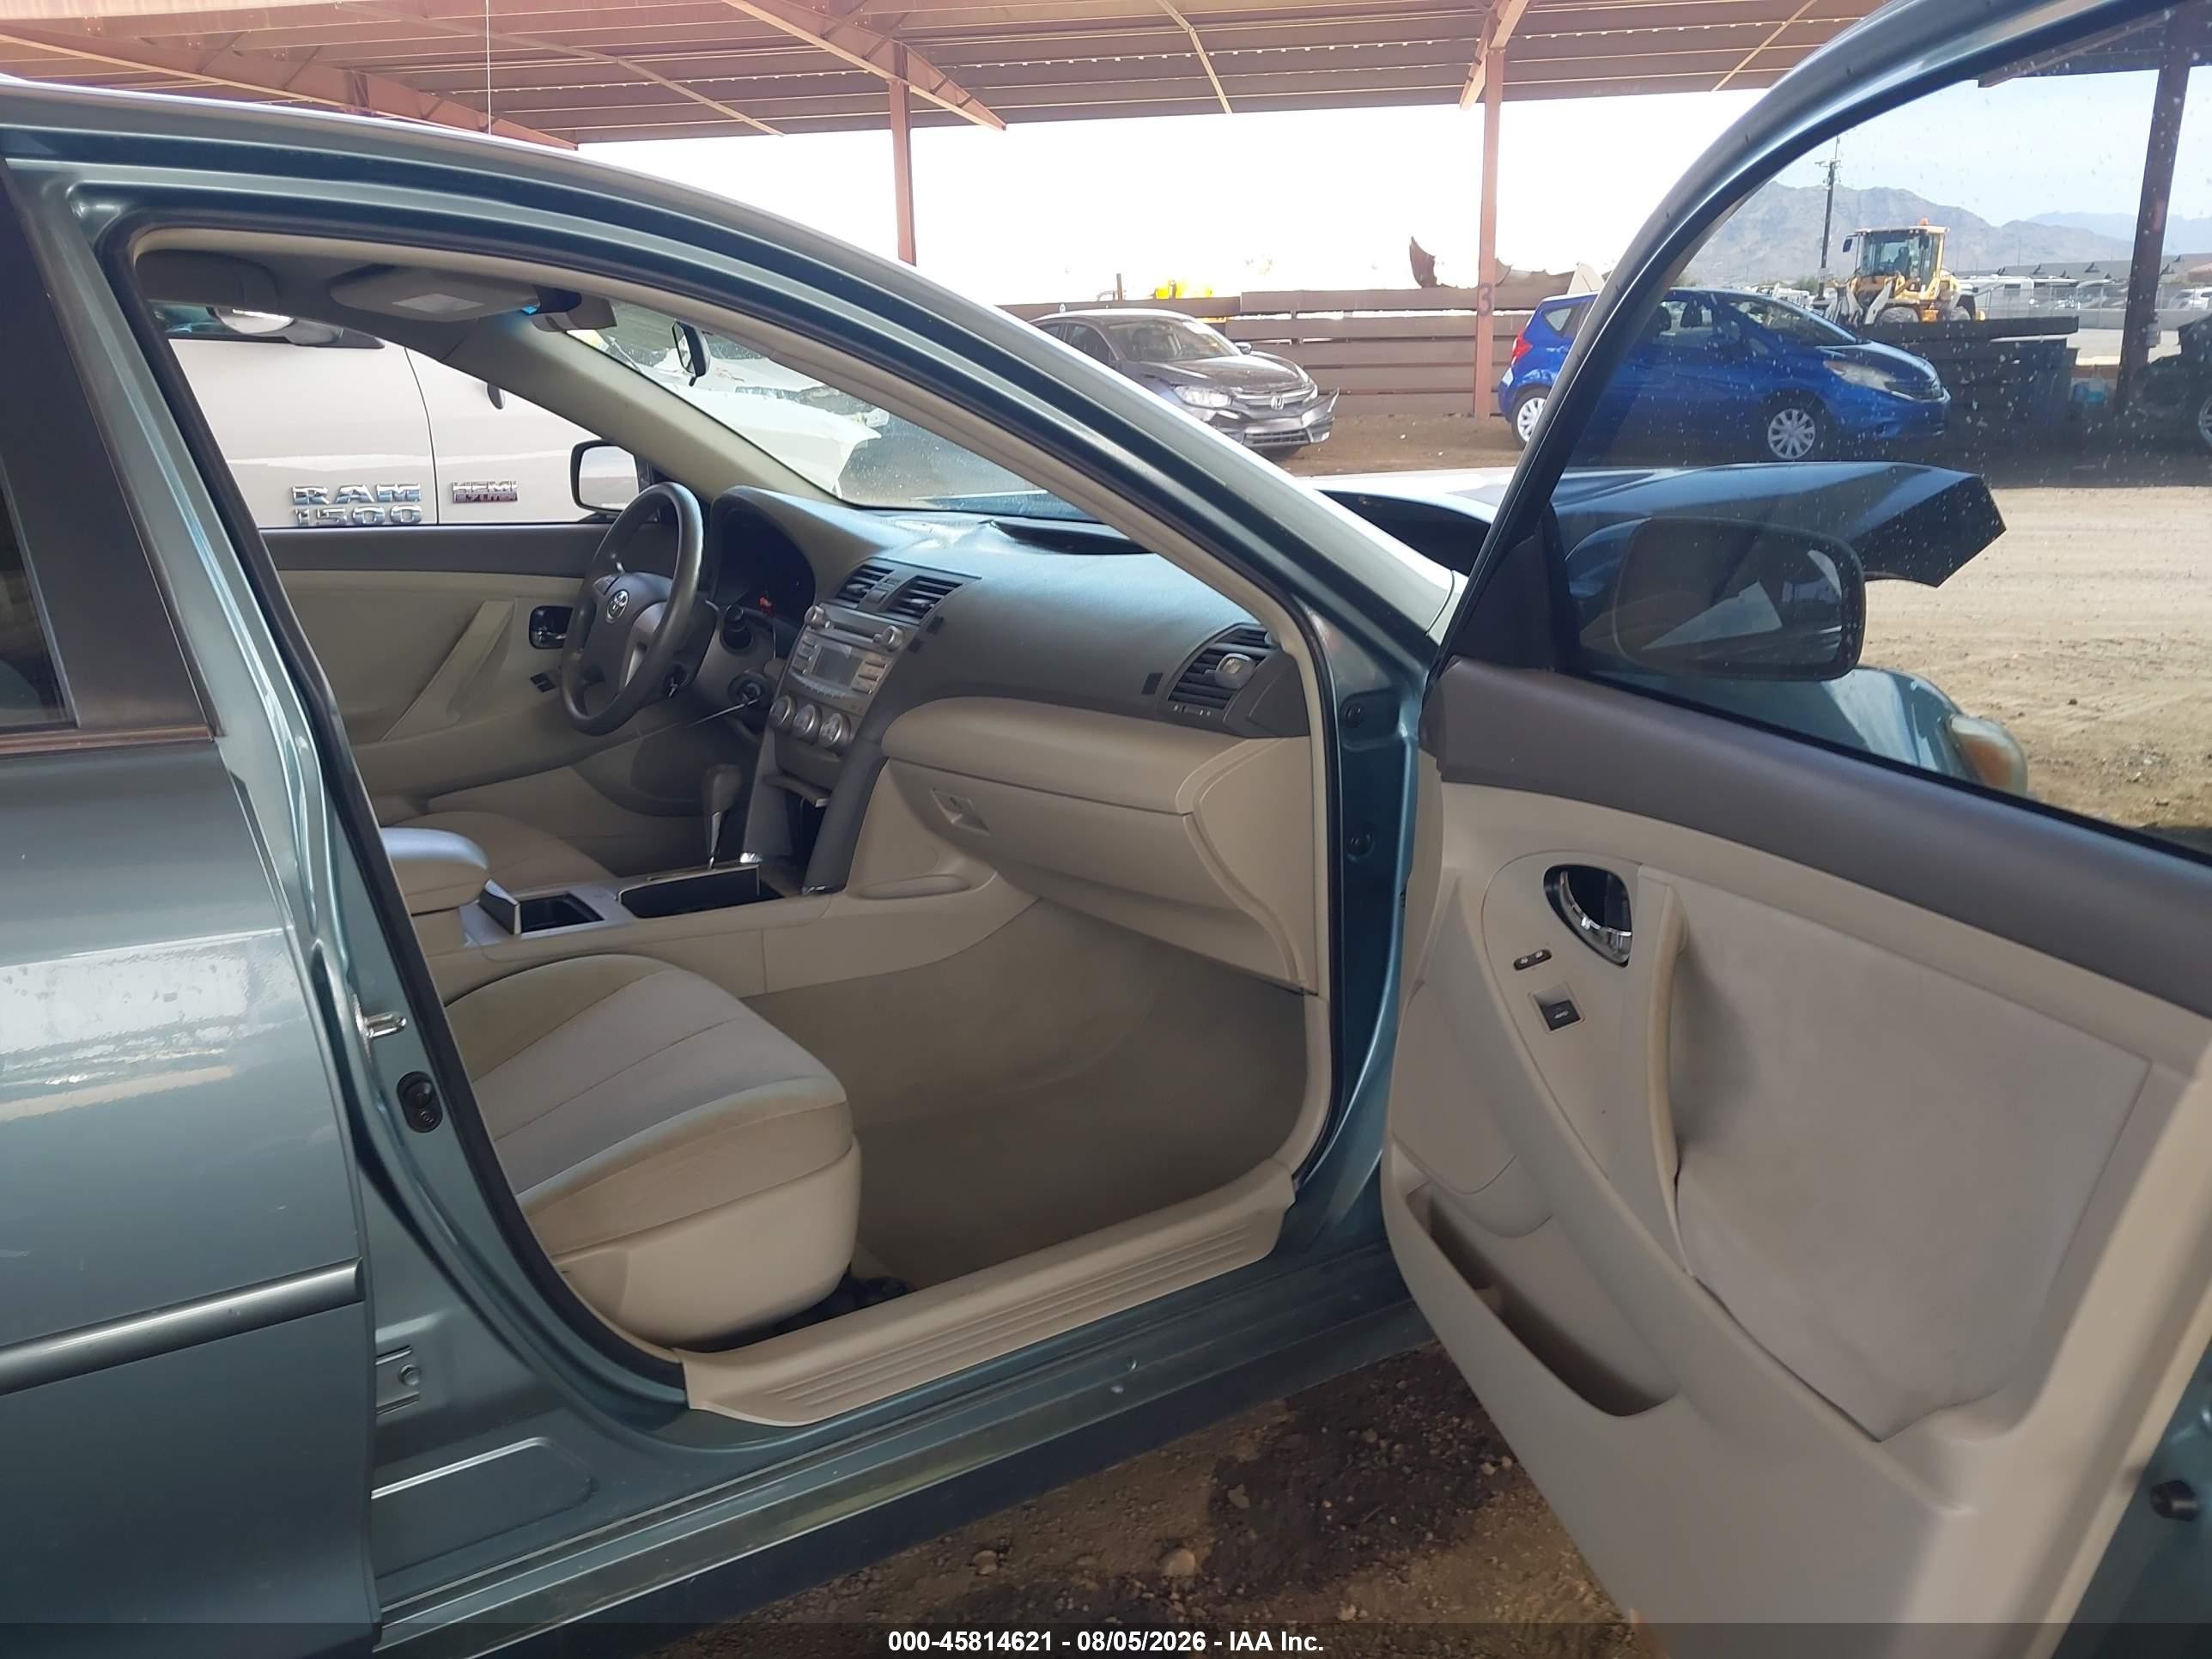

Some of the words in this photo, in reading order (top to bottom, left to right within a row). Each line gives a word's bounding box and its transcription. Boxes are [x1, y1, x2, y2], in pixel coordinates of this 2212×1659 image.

[1478, 283, 1492, 316] 3
[291, 483, 422, 505] RAM
[295, 504, 422, 526] 1500
